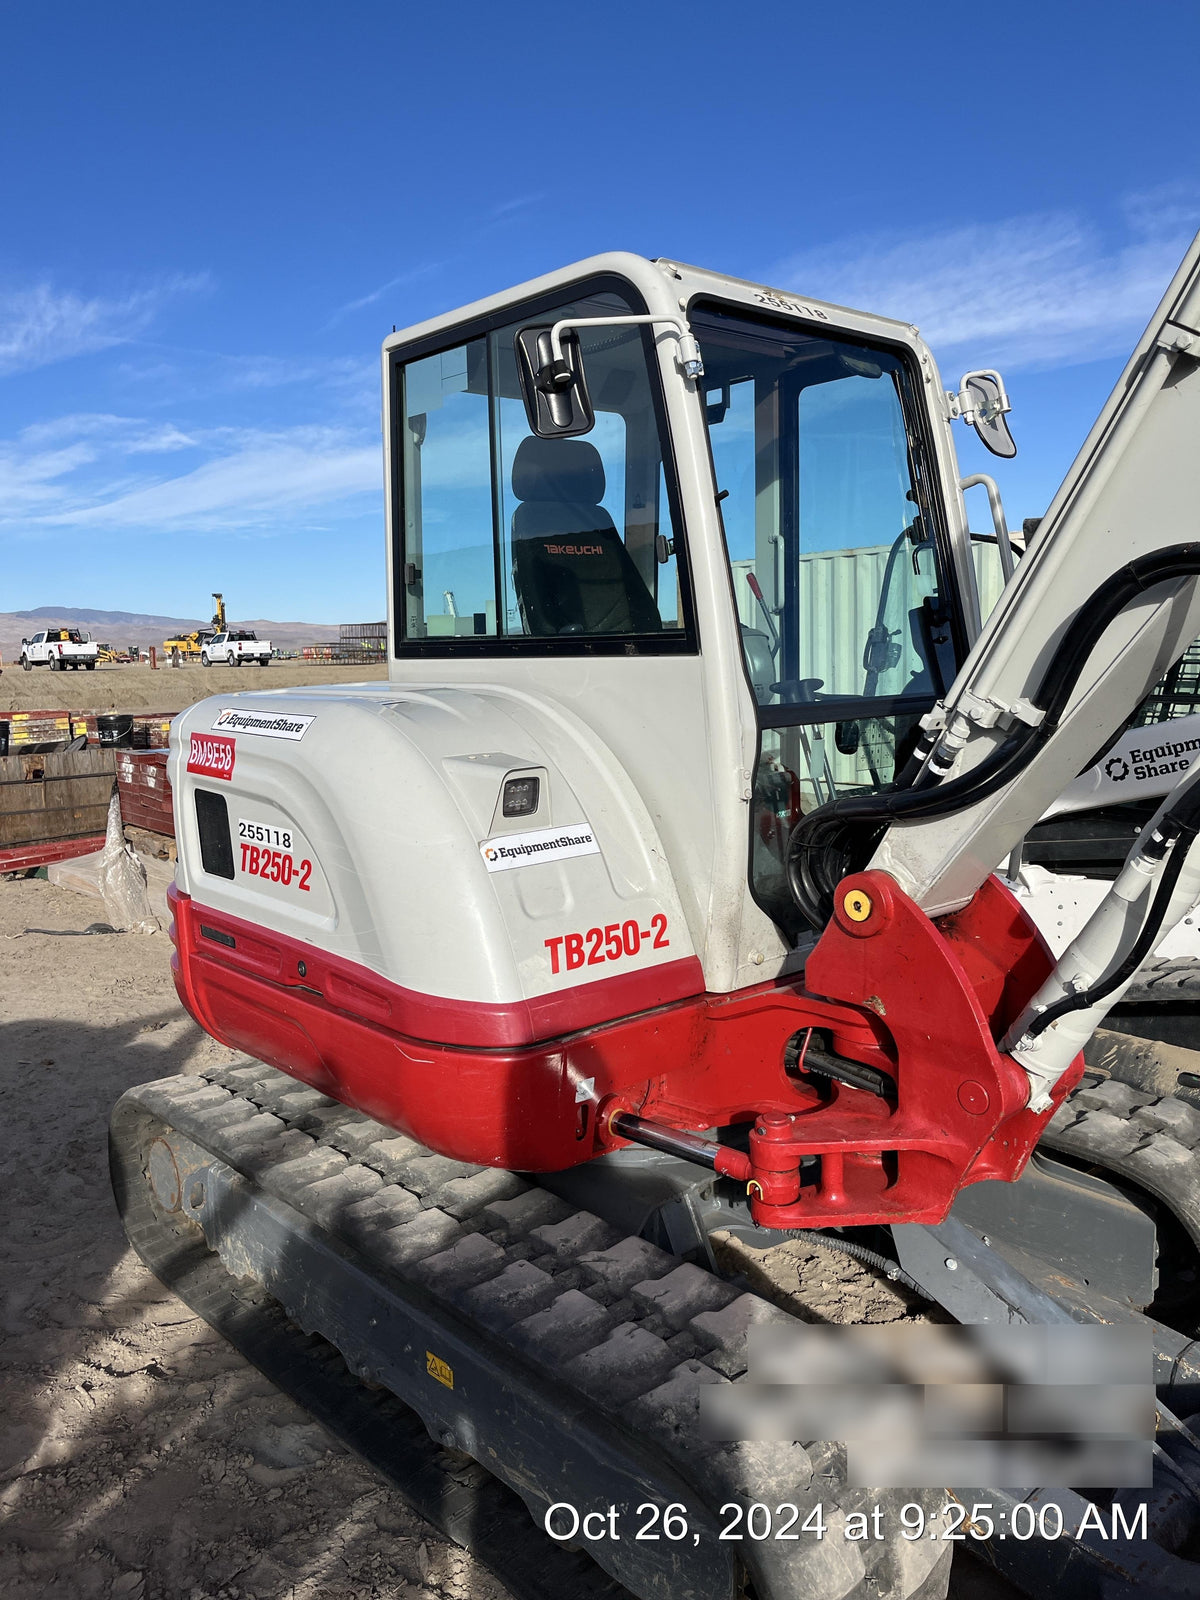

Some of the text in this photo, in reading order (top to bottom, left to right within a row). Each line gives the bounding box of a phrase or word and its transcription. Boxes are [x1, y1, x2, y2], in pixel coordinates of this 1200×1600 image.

[754, 293, 828, 320] 255118
[226, 713, 305, 733] EquipmentShare
[188, 739, 233, 771] BM9E58
[1133, 758, 1191, 781] Share
[238, 822, 292, 849] 255118
[497, 834, 593, 859] EquipmentShare
[240, 842, 312, 892] TB250-2
[544, 913, 670, 975] TB250-2
